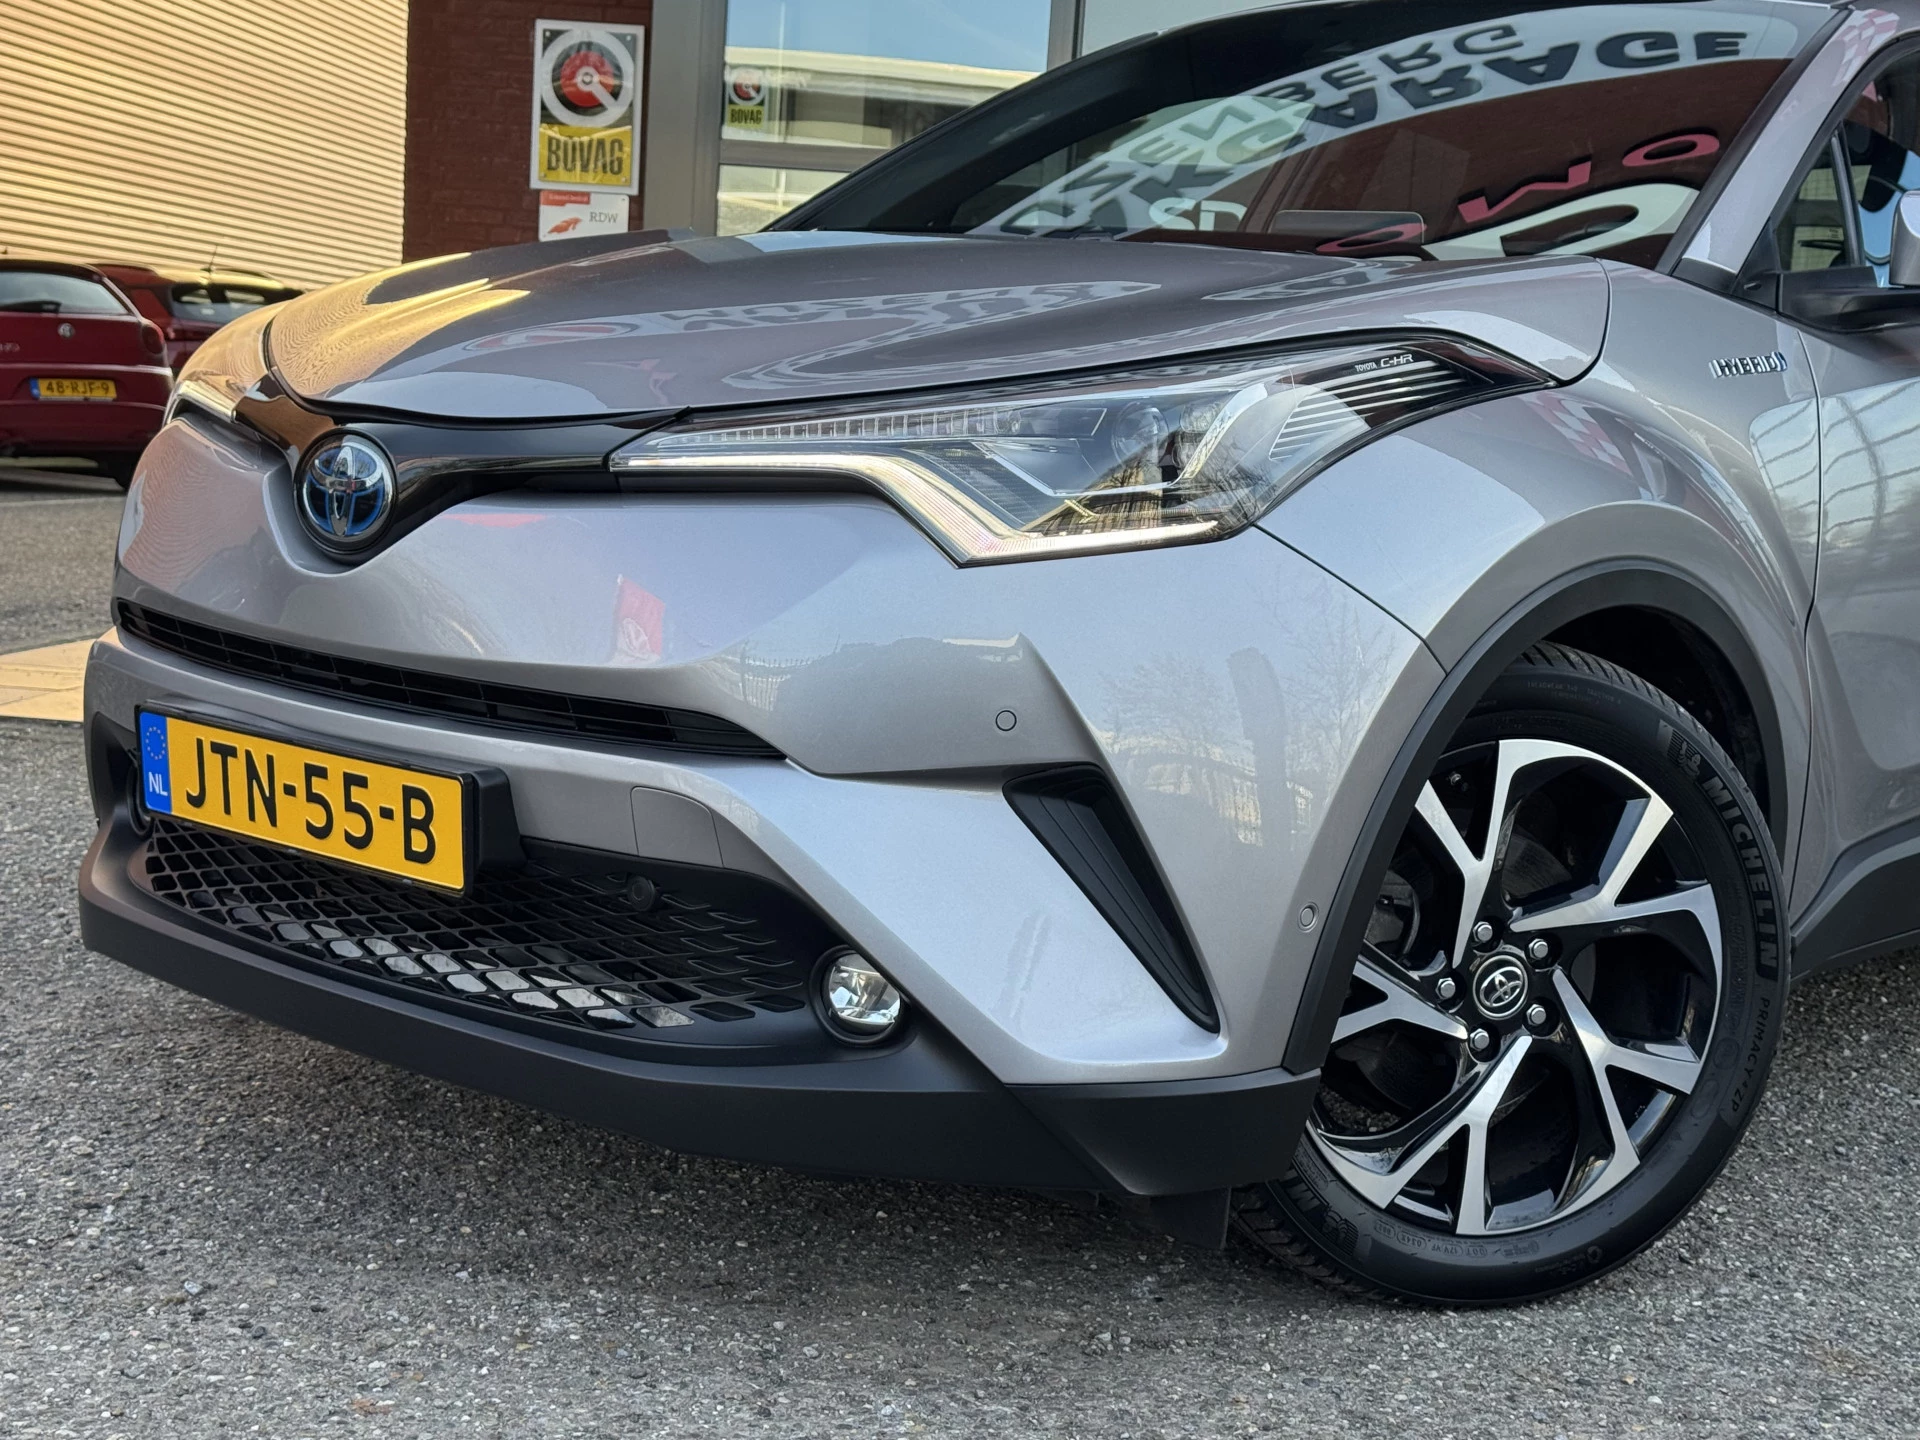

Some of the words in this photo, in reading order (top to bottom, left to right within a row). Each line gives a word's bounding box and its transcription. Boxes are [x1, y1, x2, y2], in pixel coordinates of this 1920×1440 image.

[730, 108, 763, 125] BOVAG
[547, 136, 624, 175] BOVAG
[589, 211, 619, 223] RDW
[1354, 361, 1378, 373] TOYOTA
[1380, 353, 1414, 368] C-HR
[1710, 353, 1783, 377] HYBRID
[46, 380, 110, 395] 48-RJF-9
[148, 771, 169, 797] NL
[186, 737, 437, 865] JTN-55-B
[1702, 775, 1778, 968] MICHELIN
[1743, 996, 1771, 1078] PRIMACY
